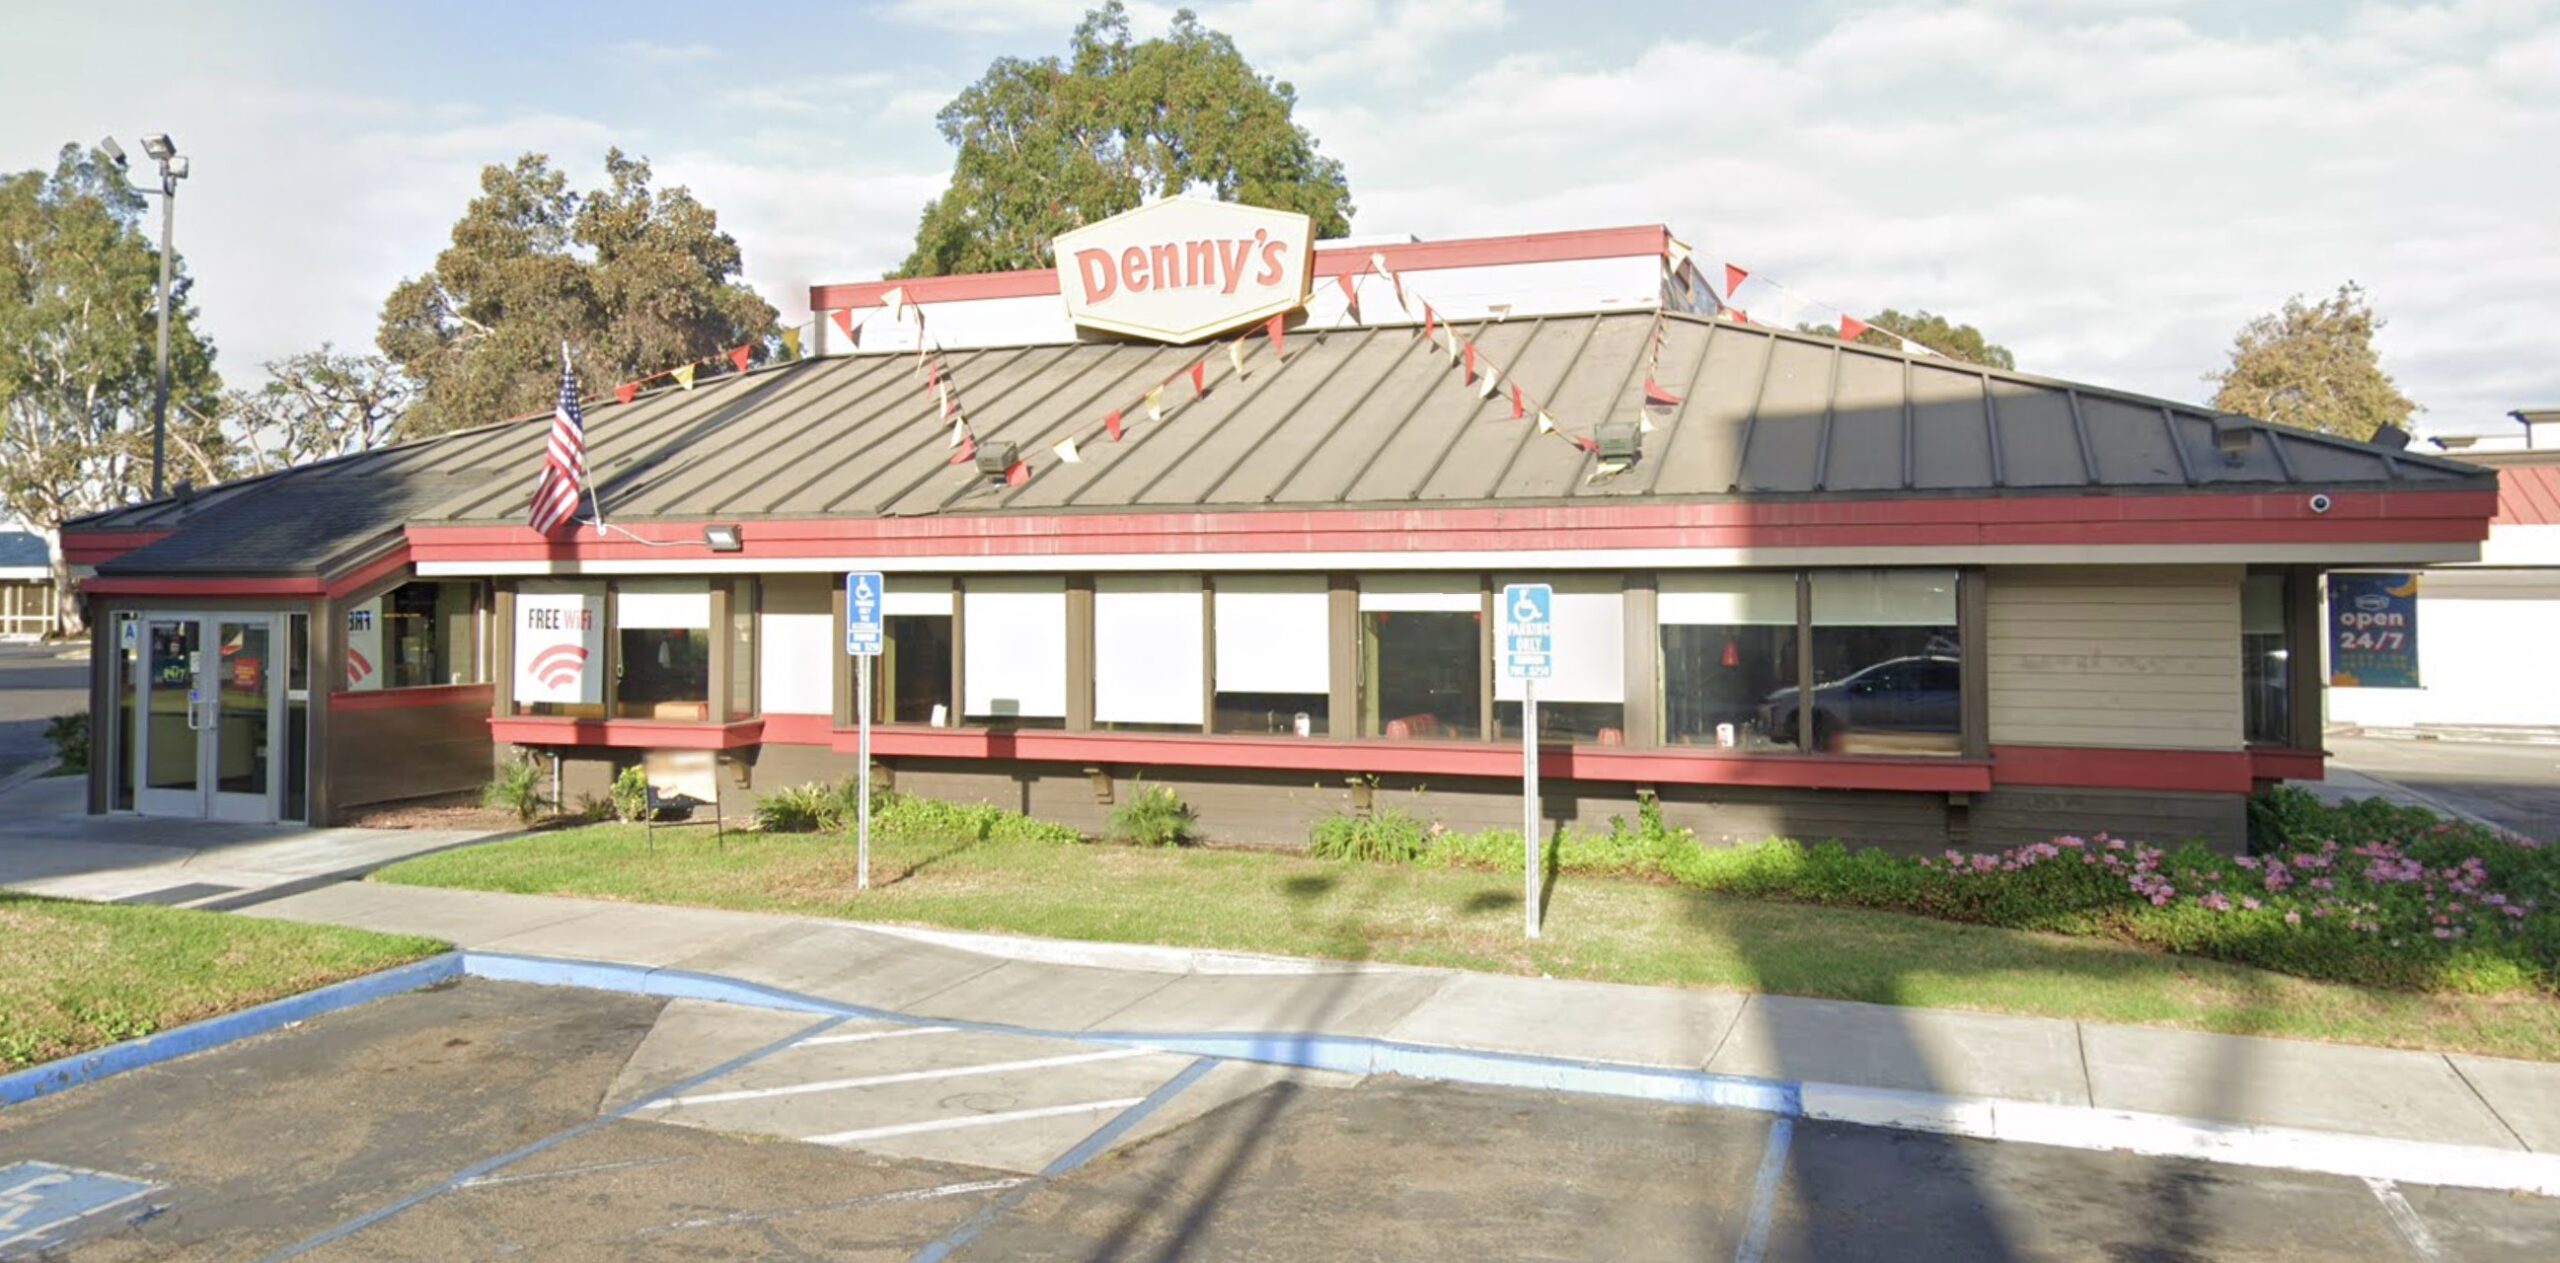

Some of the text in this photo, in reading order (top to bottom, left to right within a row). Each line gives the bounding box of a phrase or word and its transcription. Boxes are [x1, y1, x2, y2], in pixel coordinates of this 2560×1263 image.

[1074, 228, 1288, 305] Denny's
[528, 608, 560, 629] FREE
[2341, 612, 2404, 629] open
[125, 625, 135, 638] A
[2340, 632, 2404, 650] 24/7
